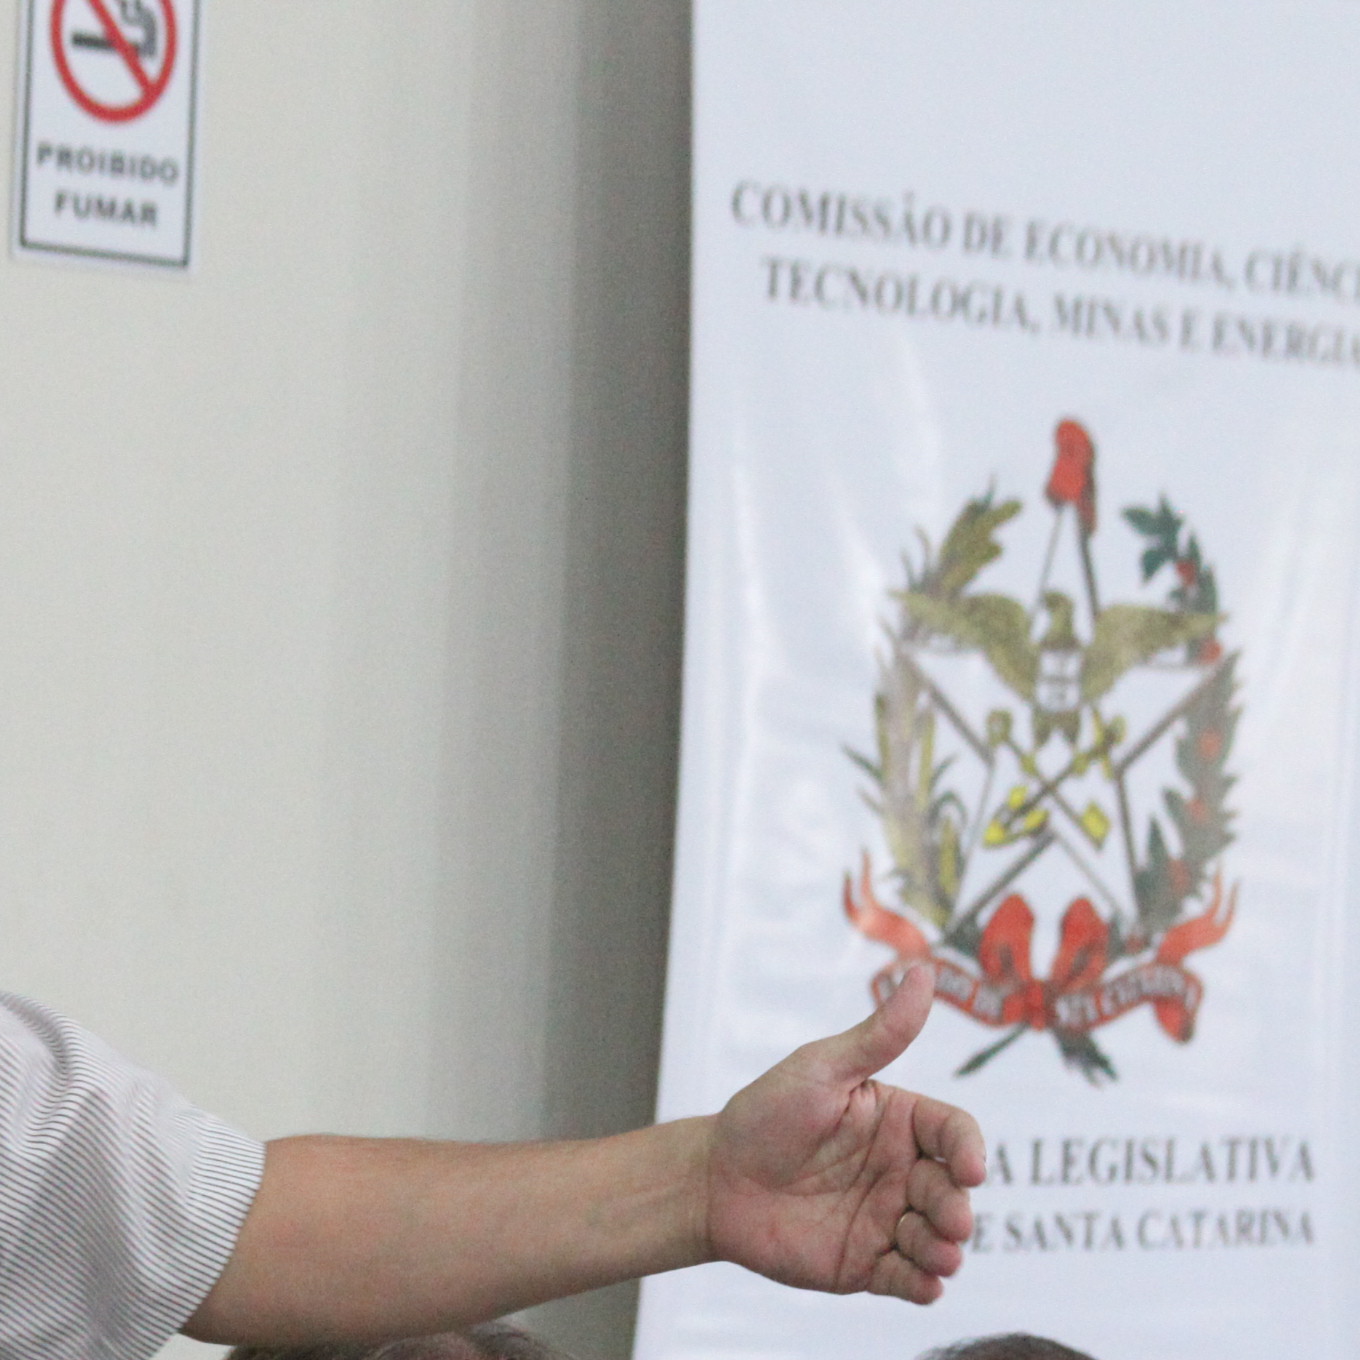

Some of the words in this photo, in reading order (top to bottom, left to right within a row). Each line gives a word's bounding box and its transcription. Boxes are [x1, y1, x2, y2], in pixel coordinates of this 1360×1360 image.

[36, 141, 179, 186] PROIBIDO
[54, 191, 158, 227] FUMAR
[731, 179, 953, 250] COMISSÃO
[963, 211, 1011, 256] DE
[1024, 218, 1235, 291] ECONOMIA,
[761, 253, 1040, 336] TECNOLOGIA,
[1052, 294, 1171, 343] MINAS
[1179, 307, 1199, 351] E
[1028, 1133, 1316, 1186] LEGISLATIVA
[1003, 1211, 1125, 1253] SANTA
[1137, 1208, 1315, 1250] CATARINA
